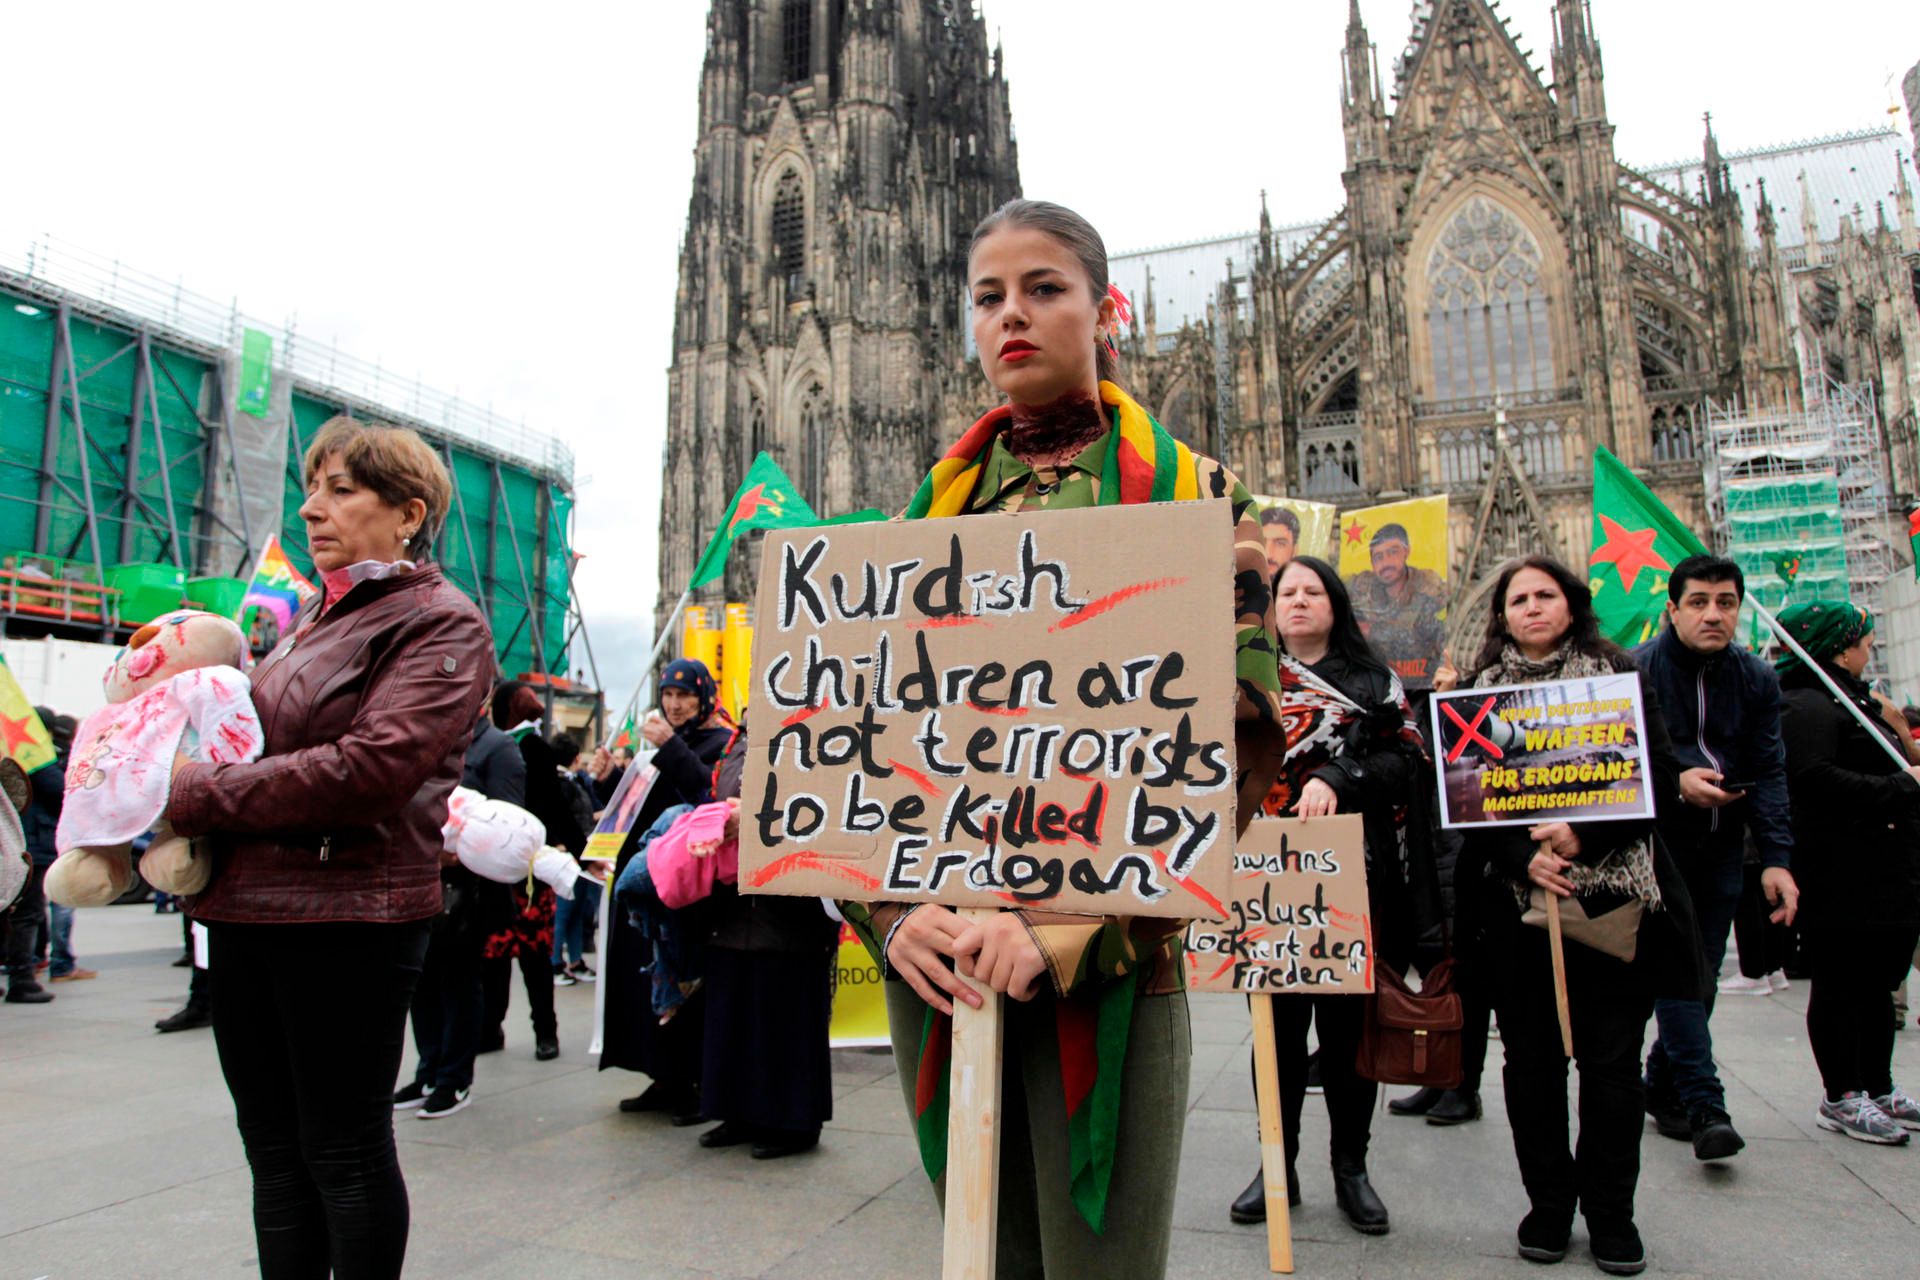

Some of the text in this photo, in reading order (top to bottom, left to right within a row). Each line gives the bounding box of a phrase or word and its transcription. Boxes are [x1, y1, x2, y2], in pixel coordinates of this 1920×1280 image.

[778, 530, 1087, 632] Kurdish
[764, 631, 1058, 712] children
[1078, 652, 1198, 709] are
[1547, 698, 1632, 717] DEUTSCHEN
[769, 703, 1231, 795] not terrorists
[1525, 722, 1627, 752] WAFFEN
[1481, 760, 1635, 789] FÜR ERODGANS
[1482, 788, 1637, 812] MACHENSCHAFTENS
[755, 773, 826, 847] to
[841, 772, 928, 834] be
[1125, 787, 1219, 878] by
[884, 836, 1170, 900] Erdogan
[1201, 881, 1329, 935] gslust
[1310, 929, 1366, 960] den
[839, 967, 881, 985] RDO
[1232, 957, 1343, 988] Frieden
